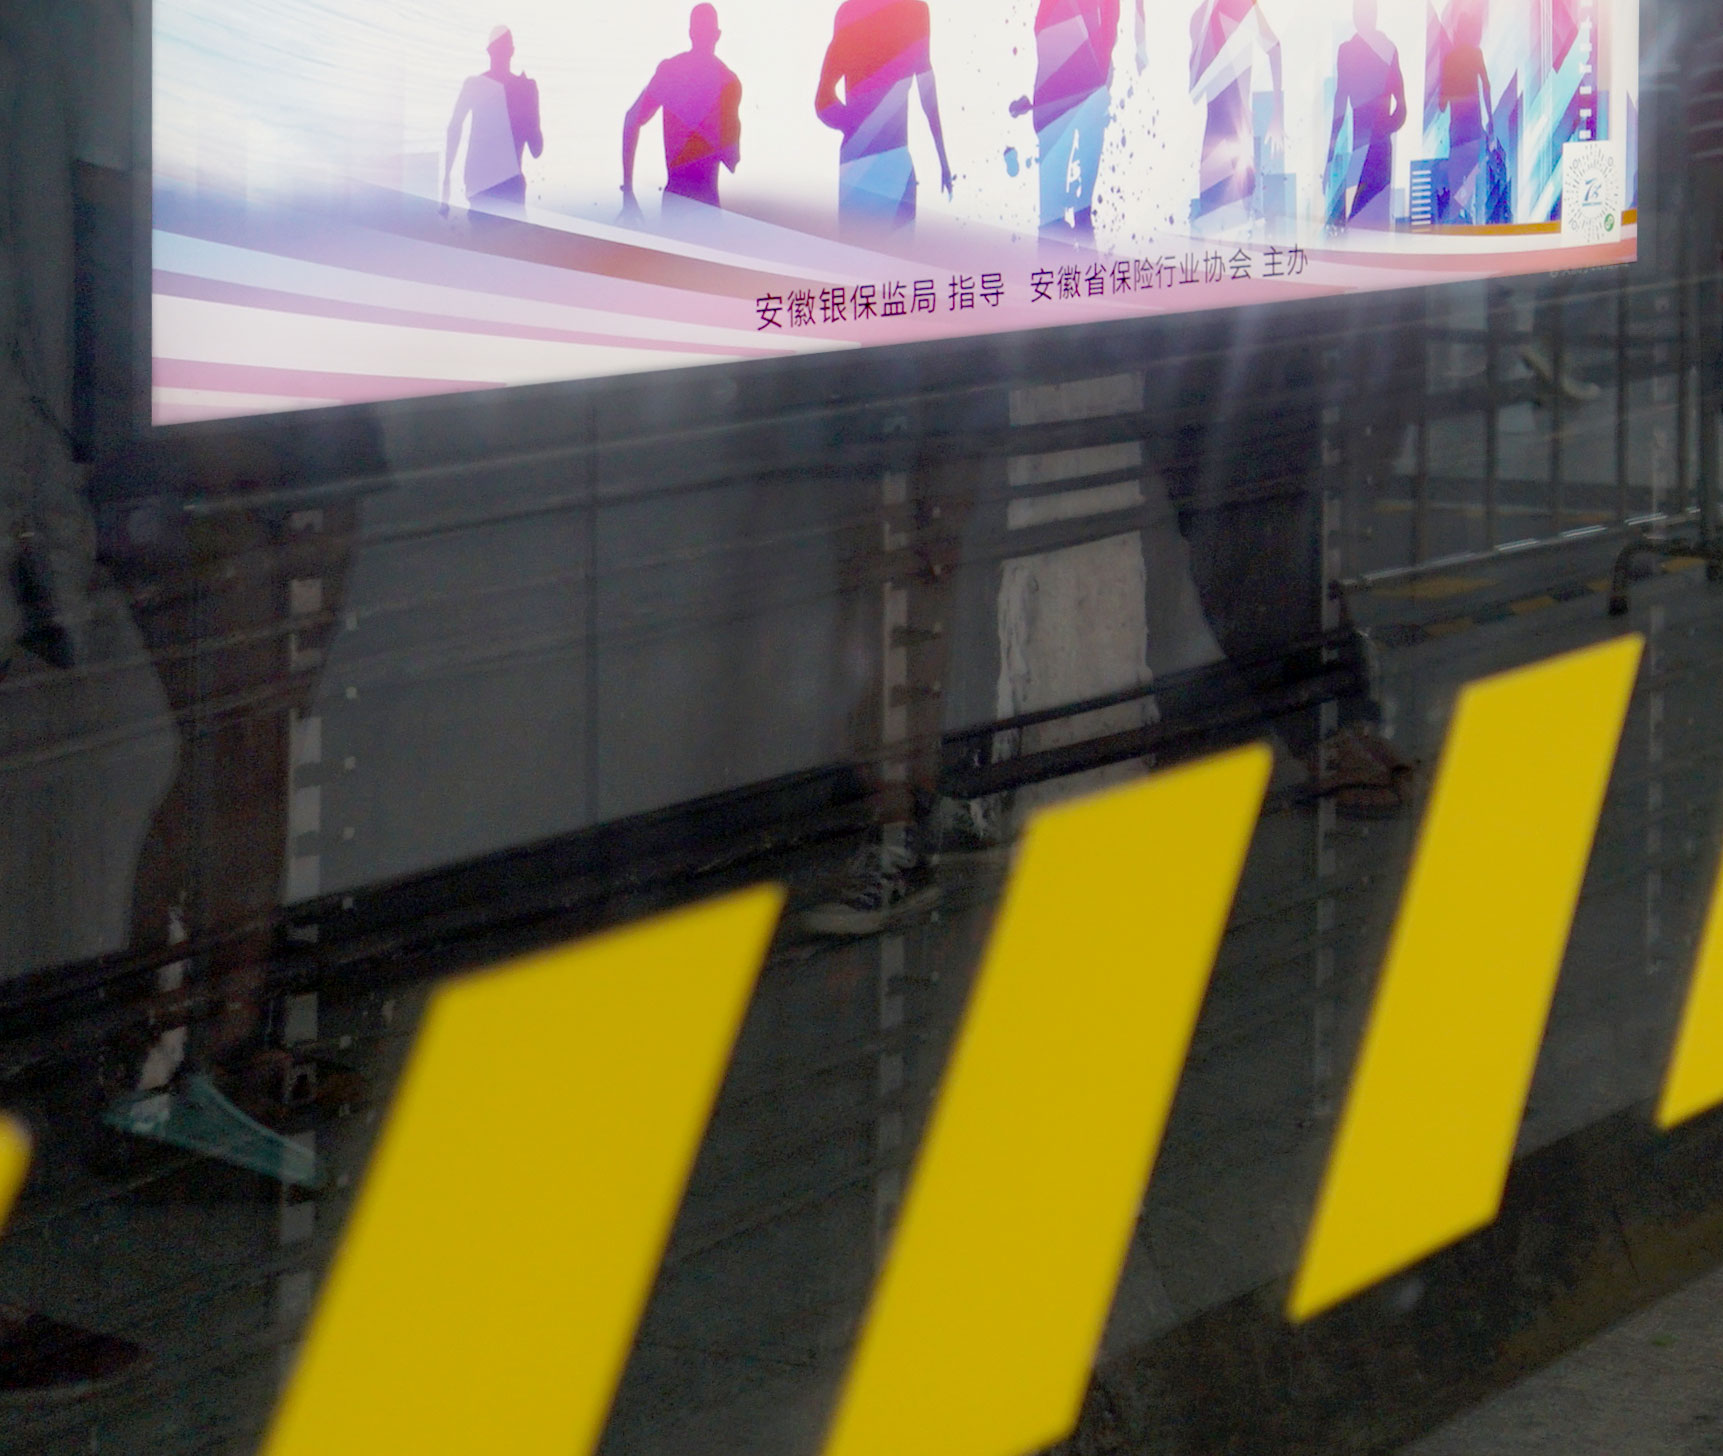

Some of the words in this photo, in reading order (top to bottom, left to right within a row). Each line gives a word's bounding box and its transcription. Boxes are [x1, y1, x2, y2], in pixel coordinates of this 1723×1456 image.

[755, 277, 938, 332] 安徽银保监局
[948, 272, 1006, 312] 指导
[1029, 246, 1253, 305] 安徽省保险行业协会
[1262, 242, 1309, 280] 主办
